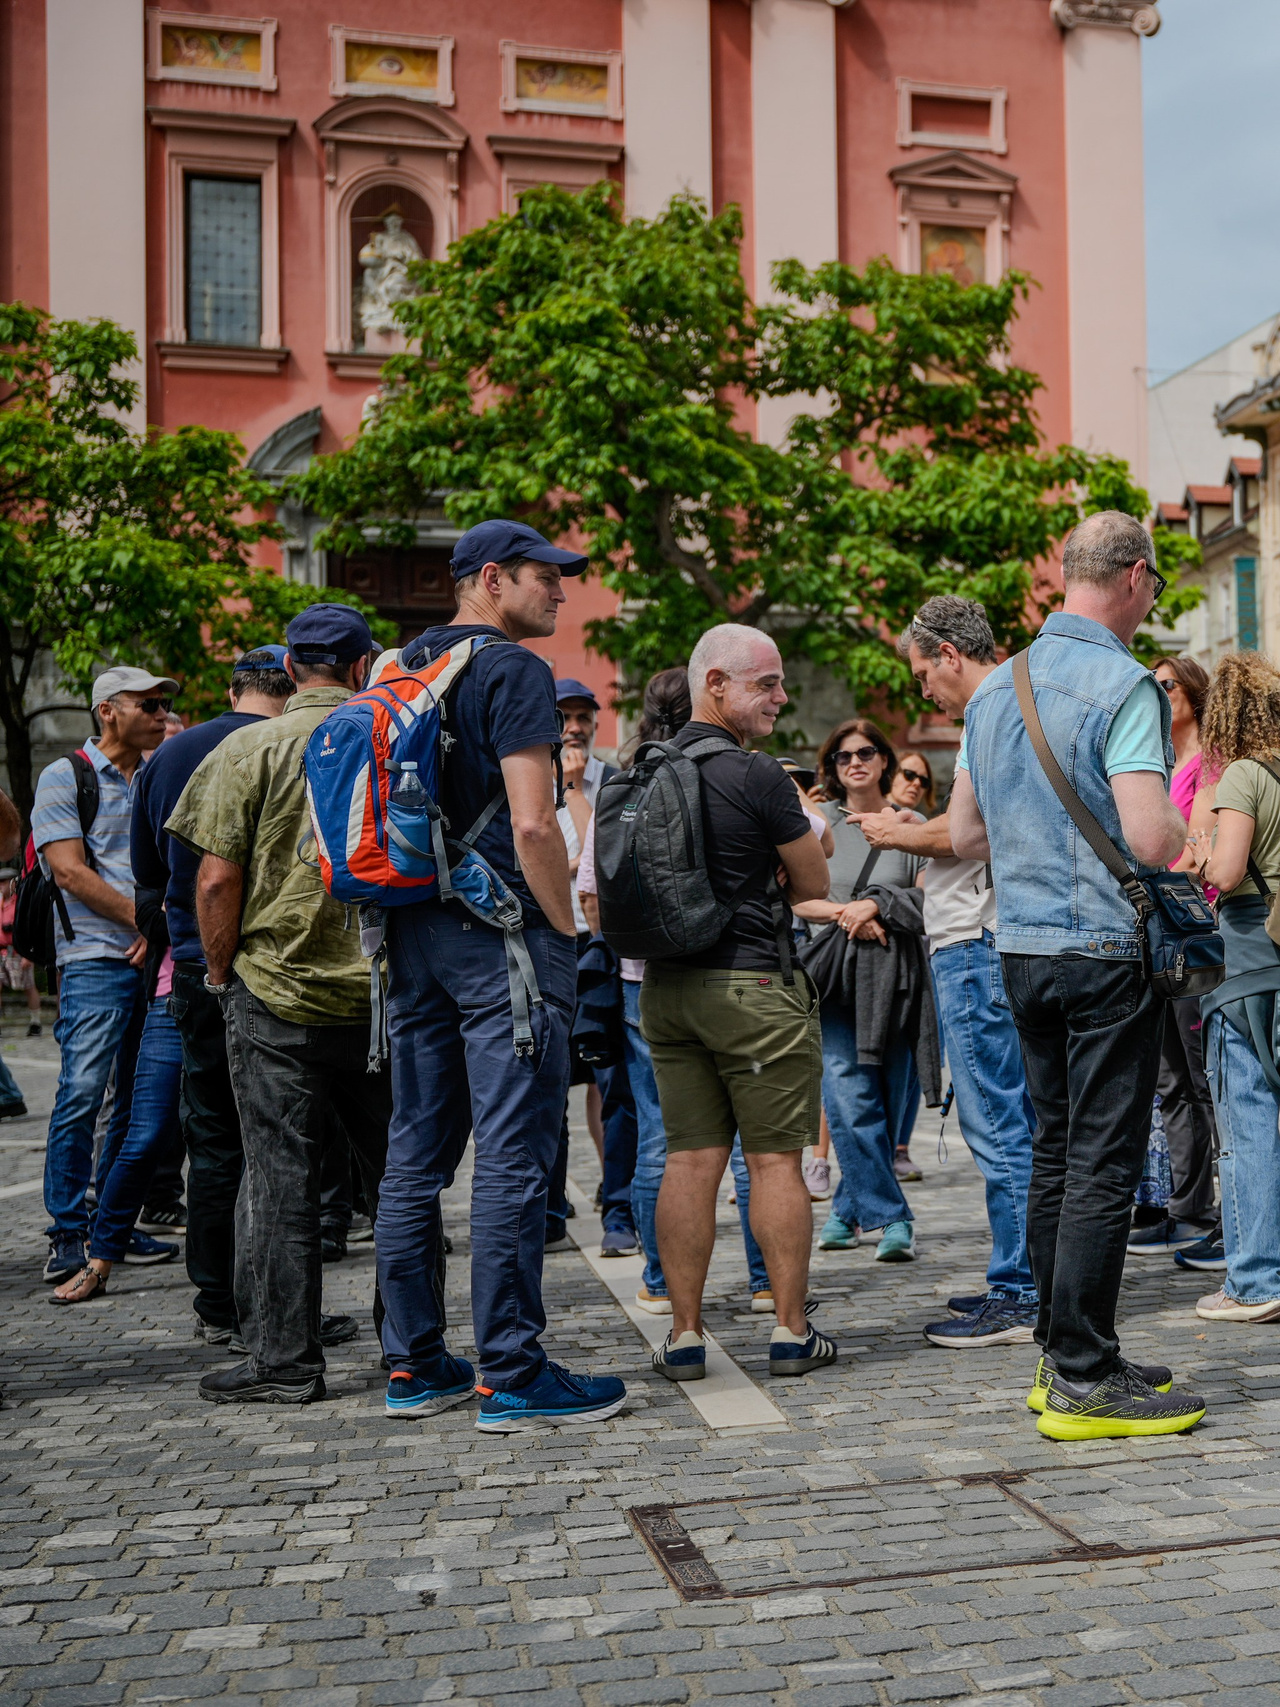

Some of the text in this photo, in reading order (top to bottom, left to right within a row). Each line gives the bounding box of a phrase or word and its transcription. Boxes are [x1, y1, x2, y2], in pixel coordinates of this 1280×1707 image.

[1238, 571, 1258, 649] ORIUM
[320, 747, 336, 757] deuter
[491, 1391, 527, 1410] HOKA
